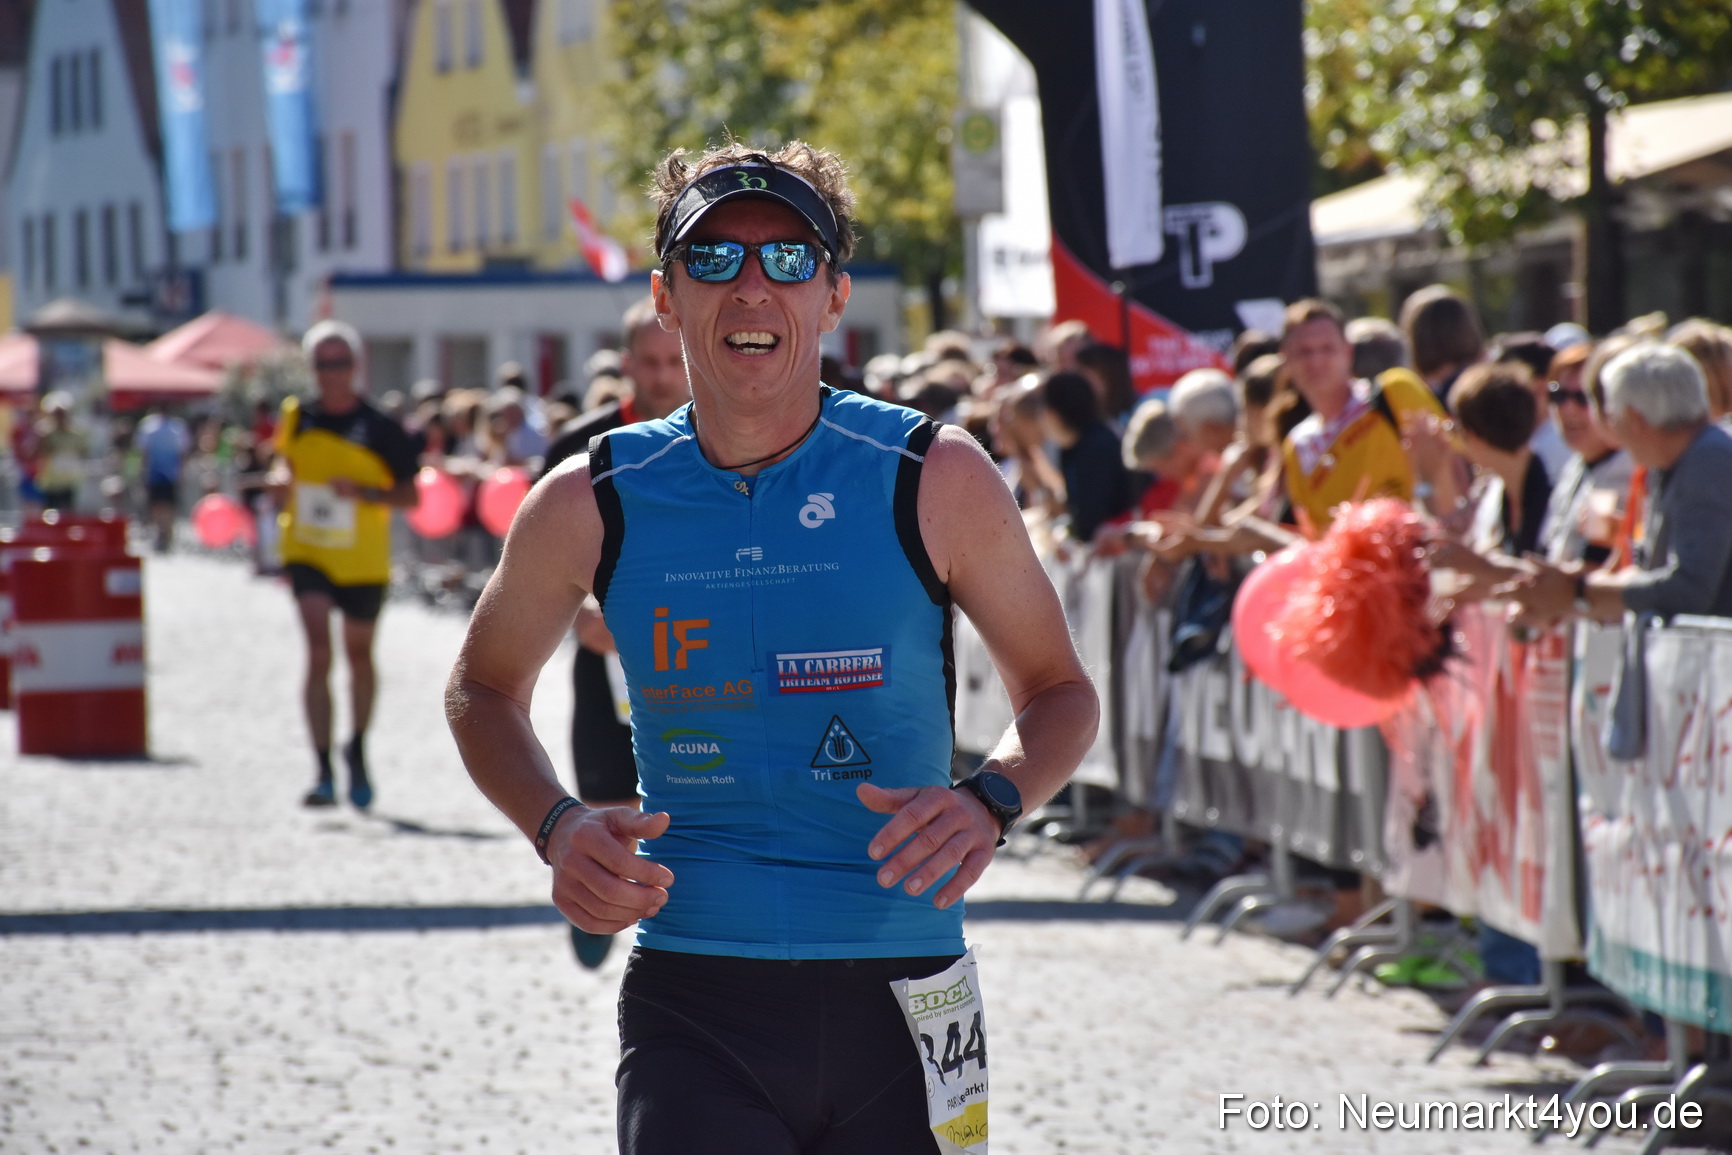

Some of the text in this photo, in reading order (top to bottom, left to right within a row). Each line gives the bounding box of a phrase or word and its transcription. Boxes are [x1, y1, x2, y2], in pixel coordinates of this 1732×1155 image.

[664, 570, 732, 582] INNOVATIVE
[777, 655, 883, 677] LA CARRERA
[722, 679, 753, 696] AG
[779, 672, 883, 688] TRITEAM ROTHSEE
[669, 742, 721, 754] ACUNA
[665, 774, 735, 785] Praxisklinik Roth
[543, 798, 577, 834] PARTICIPANT
[908, 975, 973, 1016] BOCK
[915, 1013, 934, 1022] pired
[934, 1011, 942, 1019] by
[943, 1005, 960, 1015] smart
